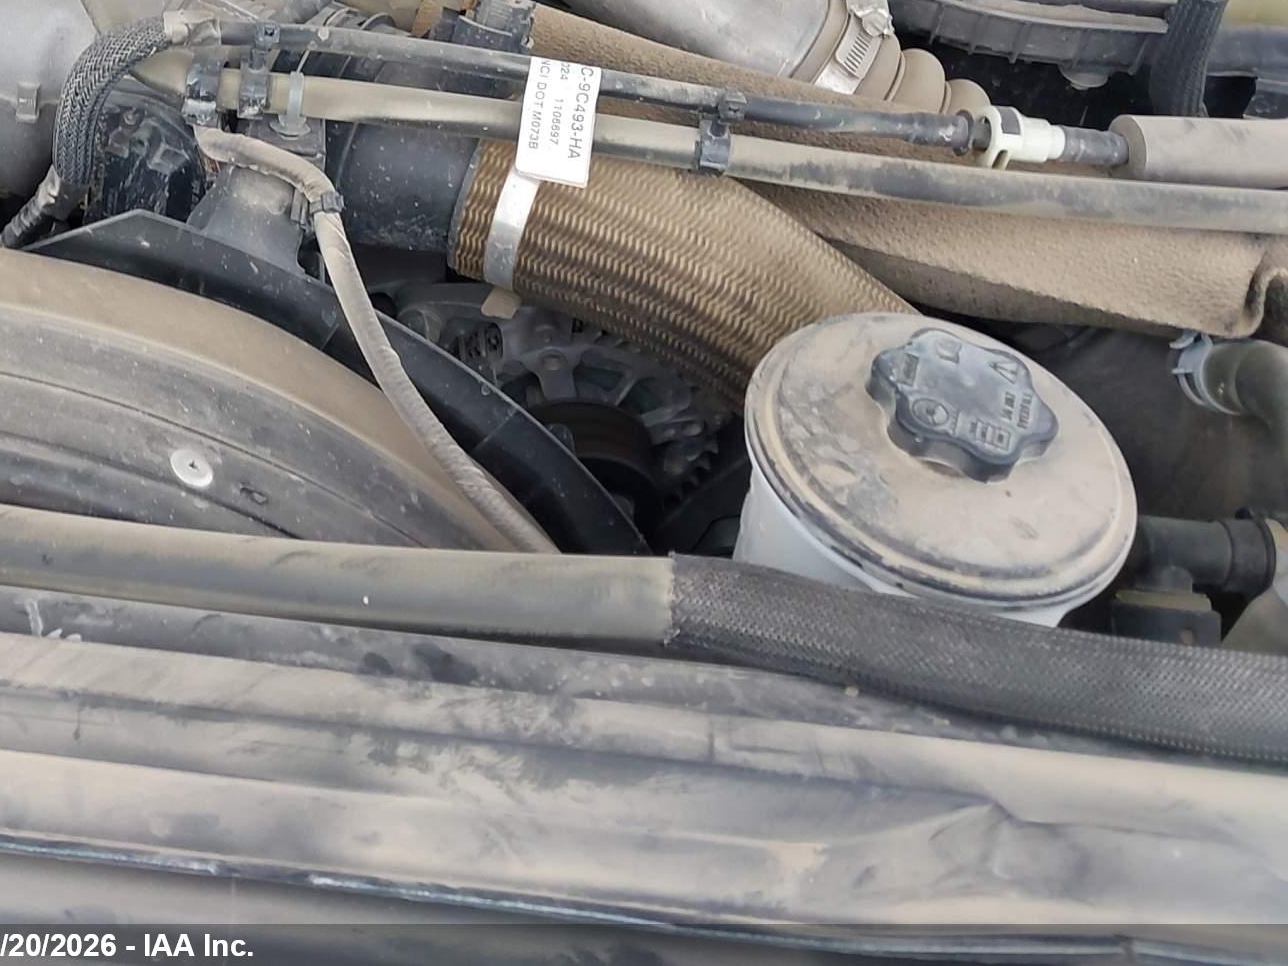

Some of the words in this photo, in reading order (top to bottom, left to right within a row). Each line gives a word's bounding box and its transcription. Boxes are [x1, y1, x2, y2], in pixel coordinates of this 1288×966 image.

[534, 82, 548, 109] DOT
[568, 66, 594, 159] C-9C493-HA
[528, 110, 542, 149] M073B
